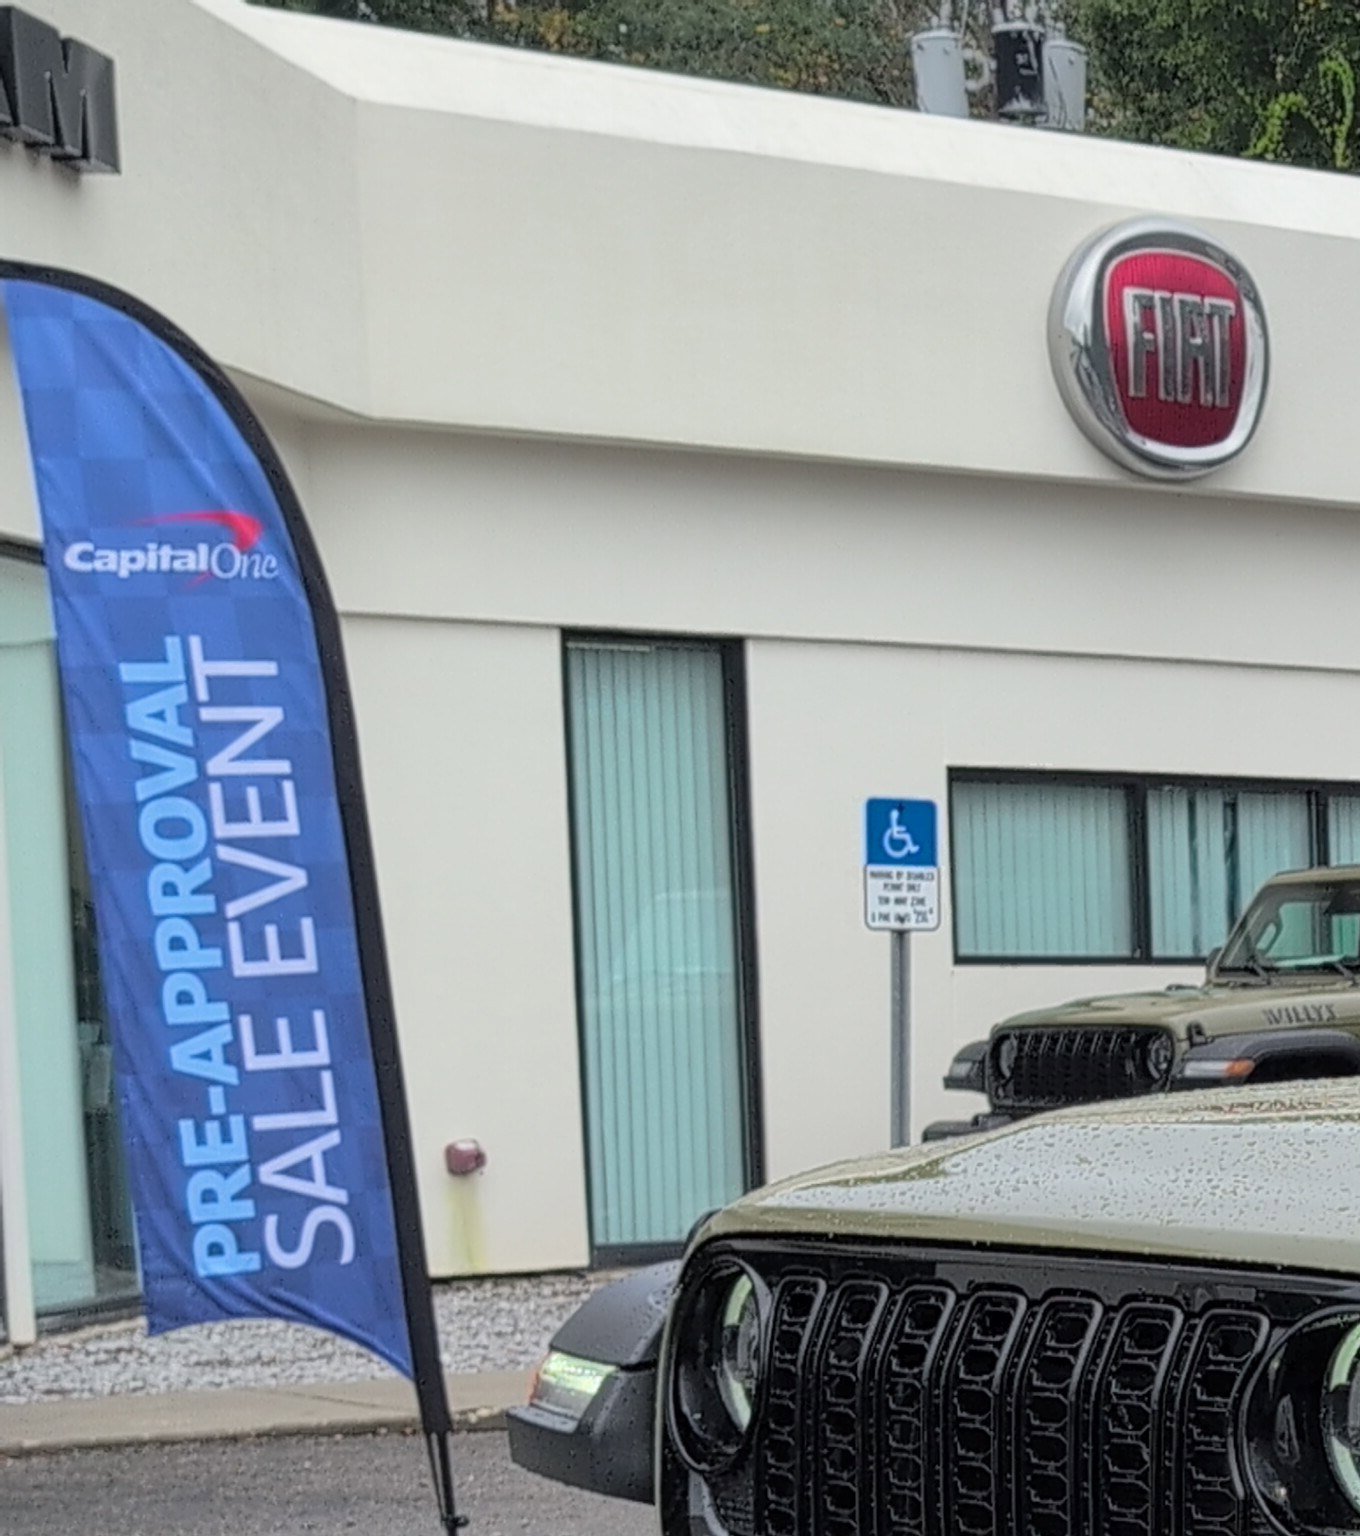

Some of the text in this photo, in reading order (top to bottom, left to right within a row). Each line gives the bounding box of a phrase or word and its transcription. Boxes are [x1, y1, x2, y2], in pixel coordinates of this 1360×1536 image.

[0, 5, 121, 175] M
[1122, 286, 1236, 409] FIAT
[119, 635, 261, 1280] PRE-APPROVAL
[188, 635, 355, 1269] SALE EVENT
[1262, 1004, 1336, 1025] WILLYS
